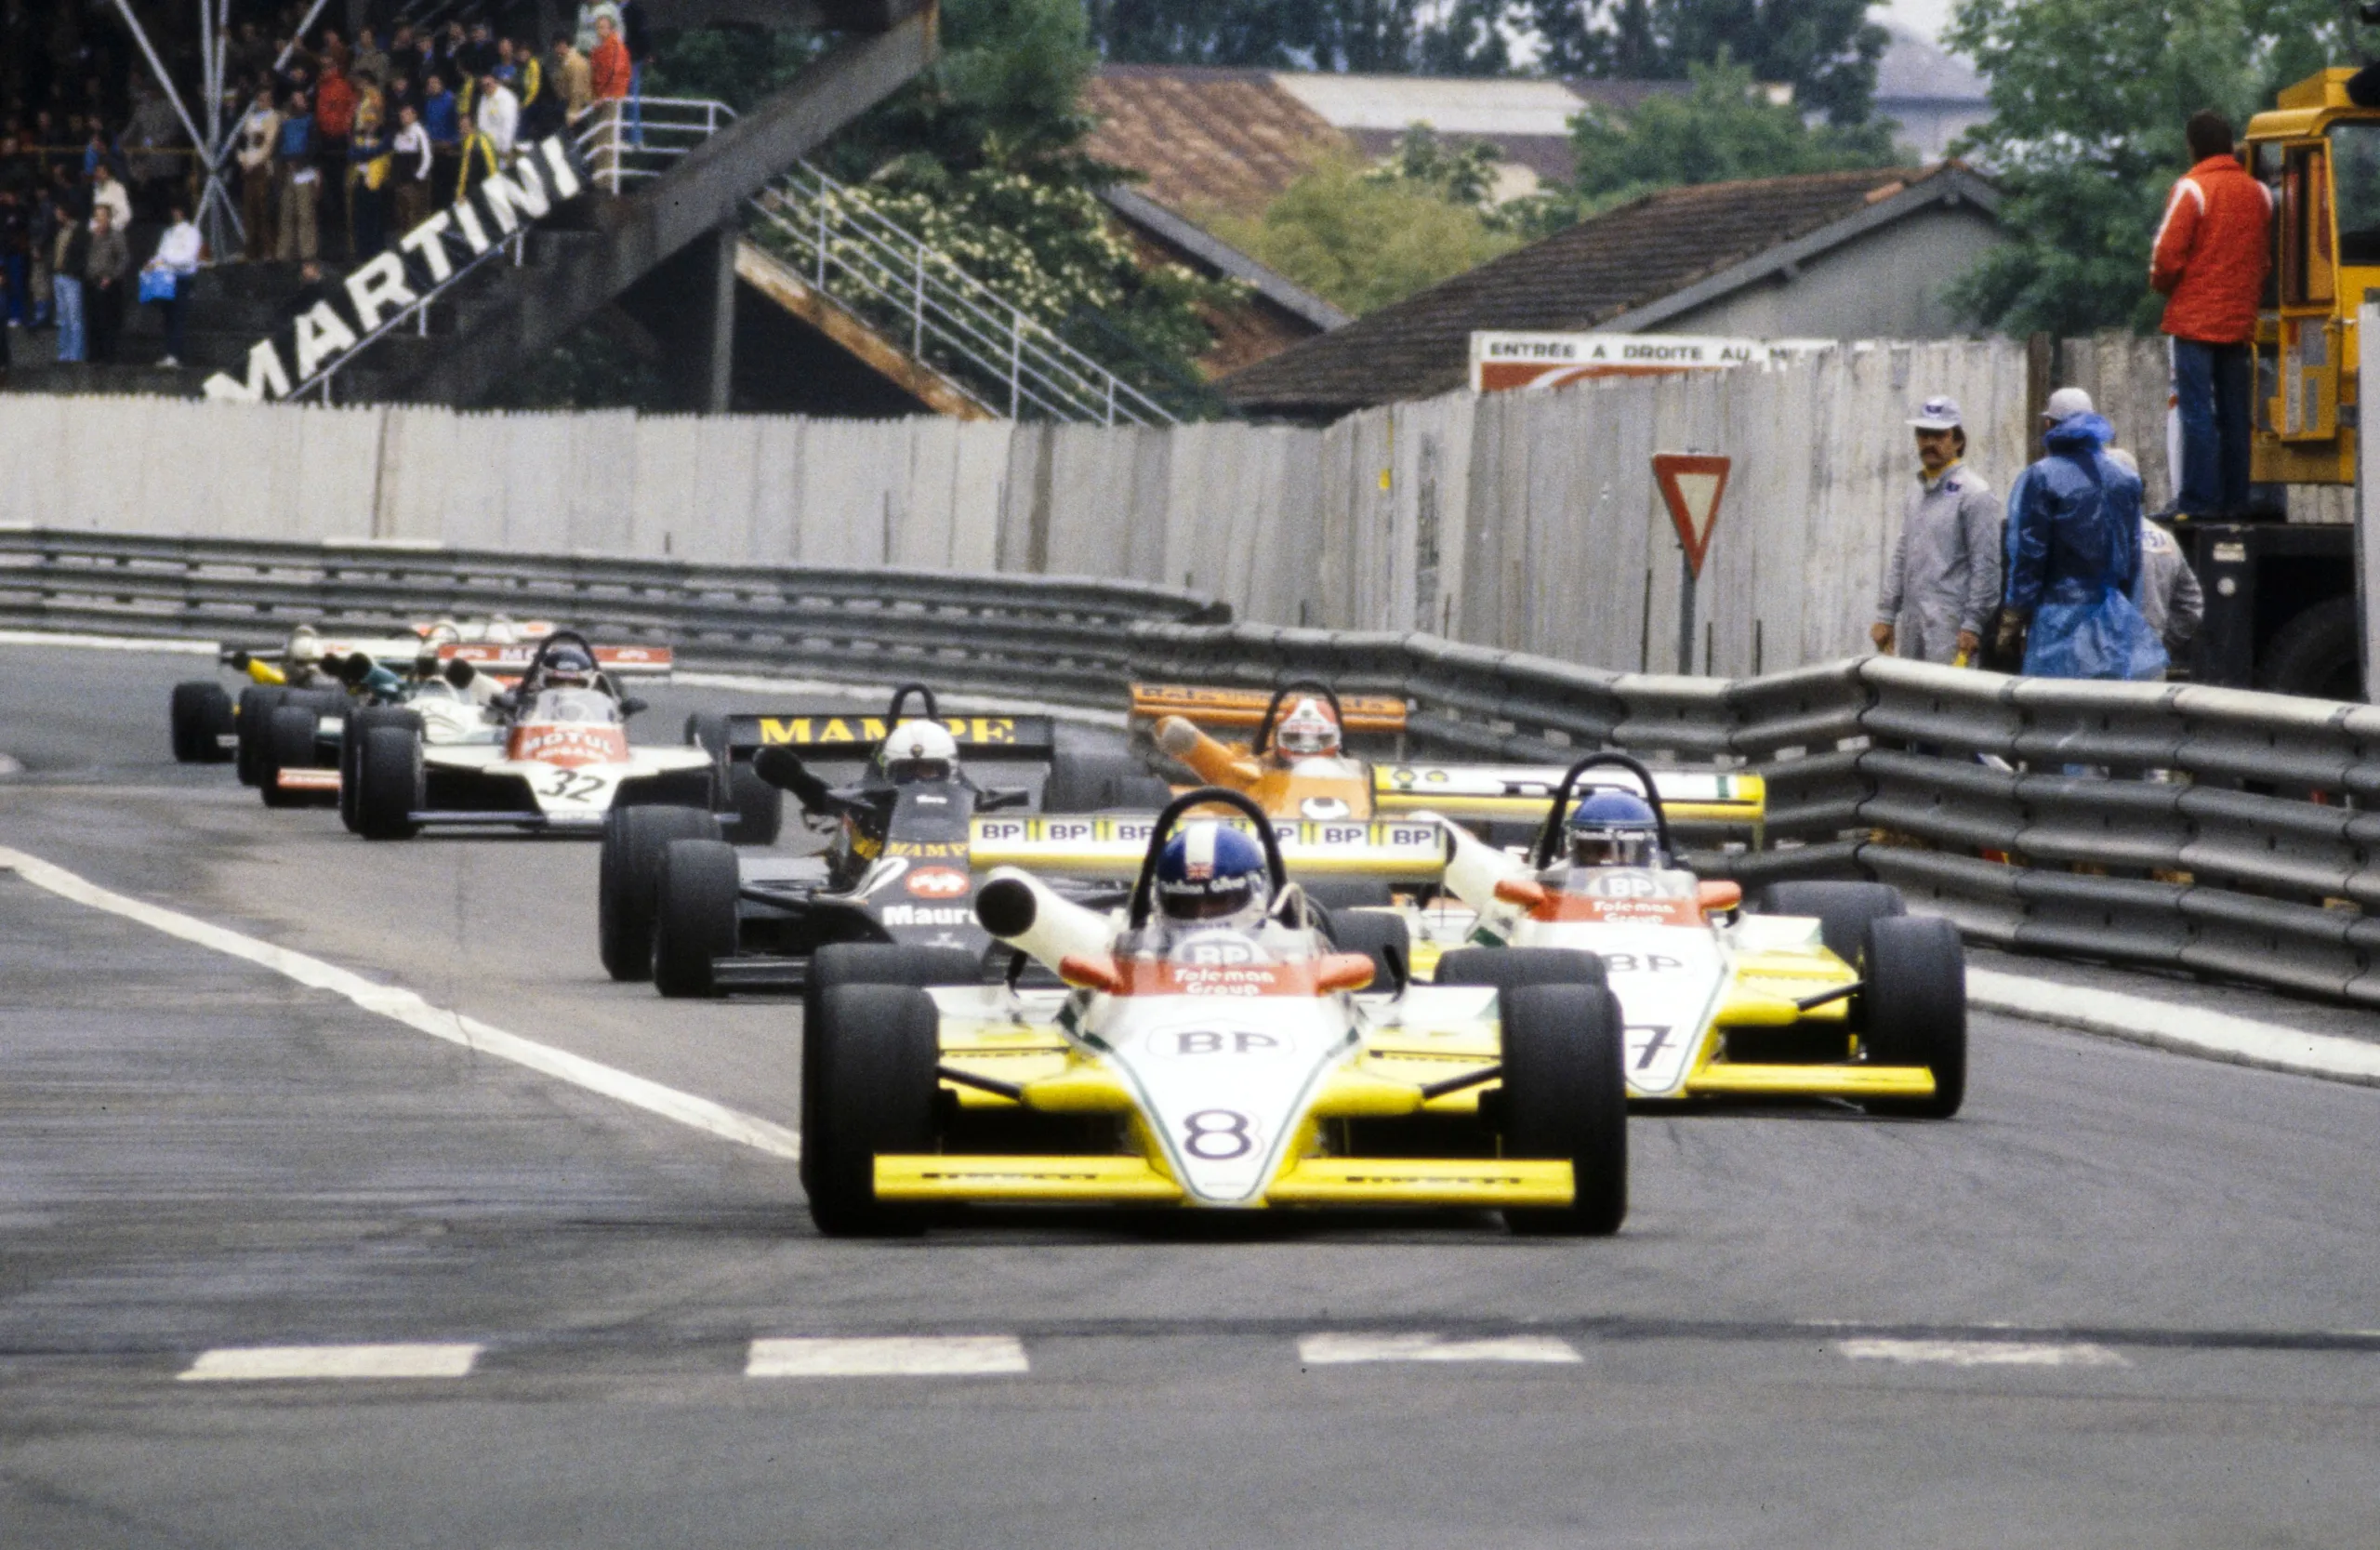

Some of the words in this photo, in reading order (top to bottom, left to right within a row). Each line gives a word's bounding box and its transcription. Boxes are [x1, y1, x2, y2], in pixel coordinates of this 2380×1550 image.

[202, 135, 582, 402] MARTINI
[1622, 344, 1703, 360] DROITE
[1719, 346, 1751, 362] AU
[522, 730, 614, 757] MOTUL
[537, 769, 608, 803] 32
[981, 824, 1021, 841] BP
[1049, 824, 1088, 841] BP
[1324, 828, 1363, 843] BP
[1393, 829, 1432, 845] BP
[1607, 877, 1655, 897] BP
[1592, 901, 1675, 913] Toleman
[1194, 944, 1250, 965] BP
[1599, 953, 1683, 973] BP
[1174, 967, 1276, 983] Toleman
[1186, 981, 1260, 996] Group
[1176, 1030, 1280, 1056] BP
[1624, 1025, 1676, 1071] 7
[1183, 1107, 1252, 1161] 8
